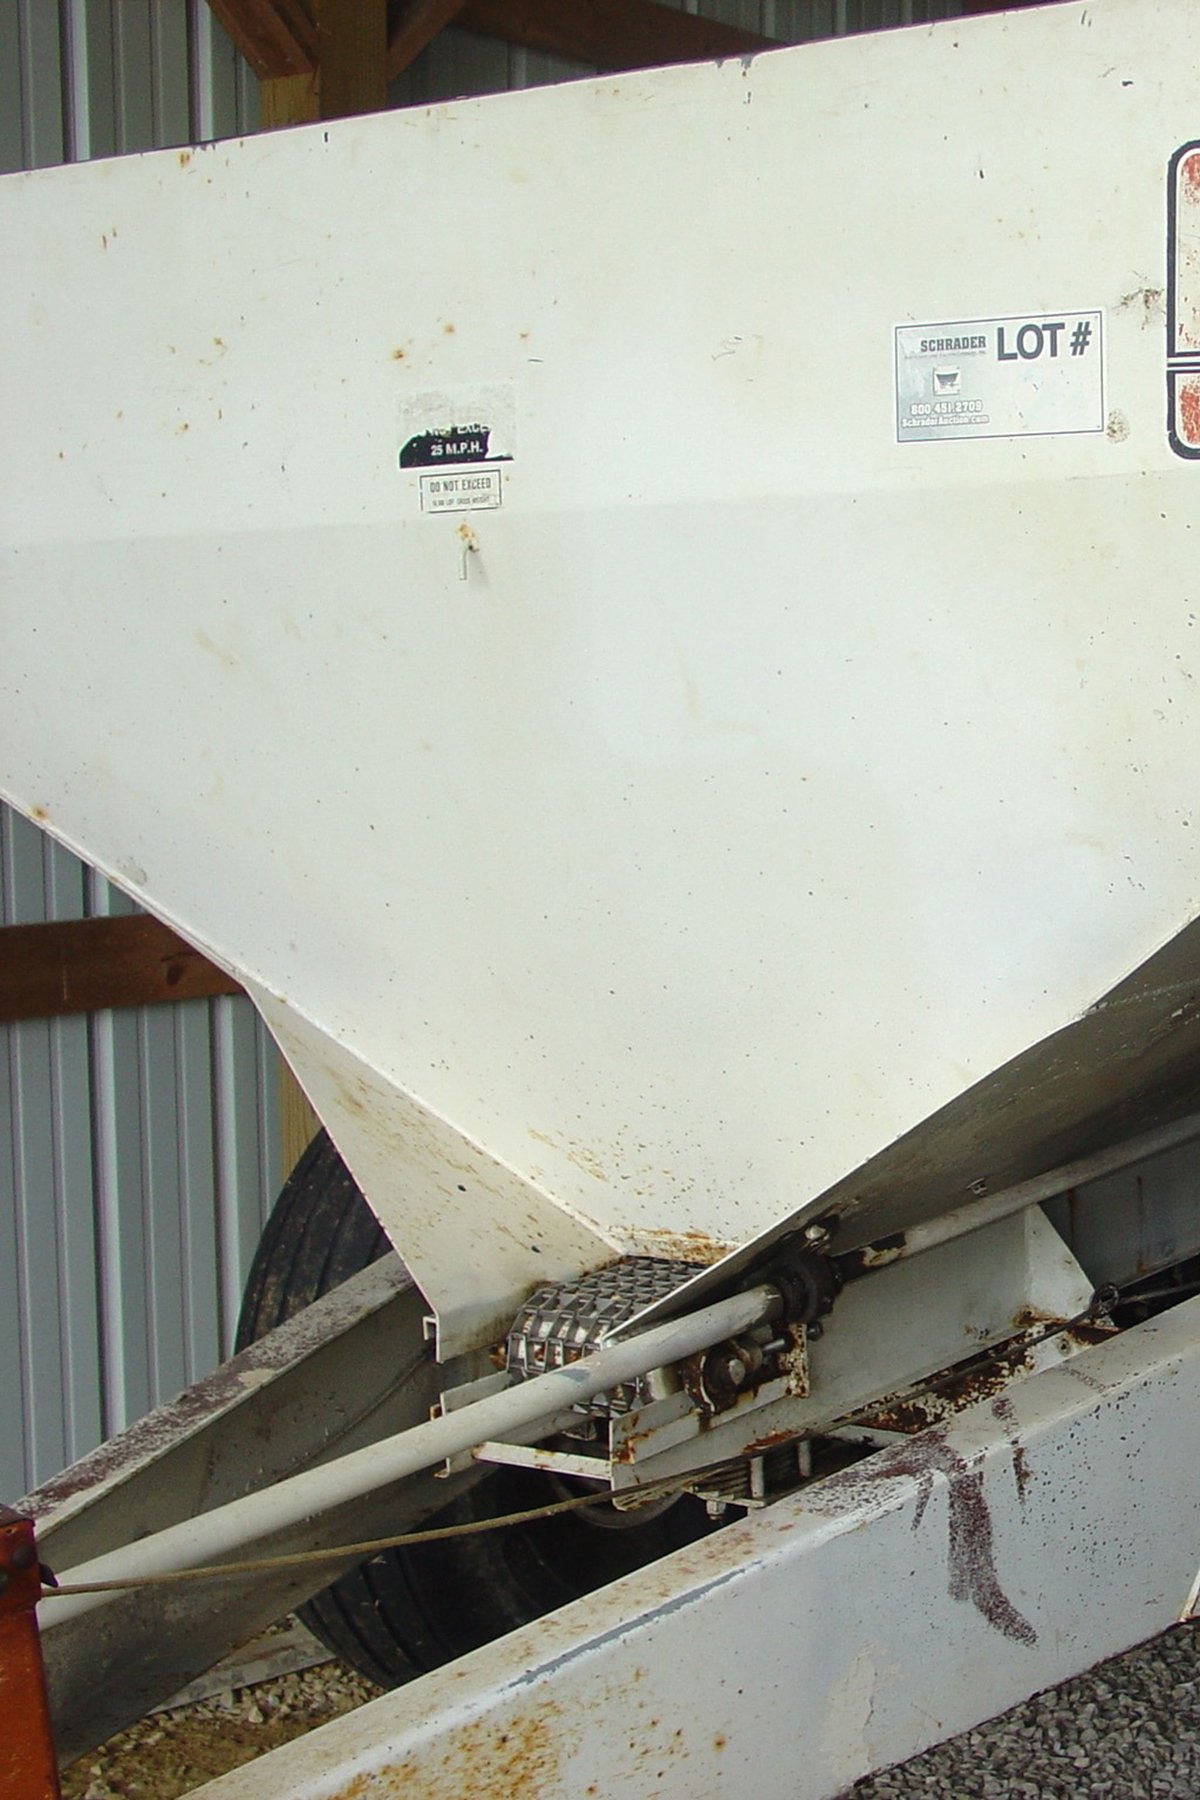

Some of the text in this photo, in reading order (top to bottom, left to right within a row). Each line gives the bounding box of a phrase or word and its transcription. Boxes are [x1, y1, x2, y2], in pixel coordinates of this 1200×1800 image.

[920, 335, 987, 353] SCHRADER
[997, 321, 1092, 362] LOT #
[430, 440, 484, 456] 25 M.P.H.
[429, 477, 492, 493] DO NOT EXCEED
